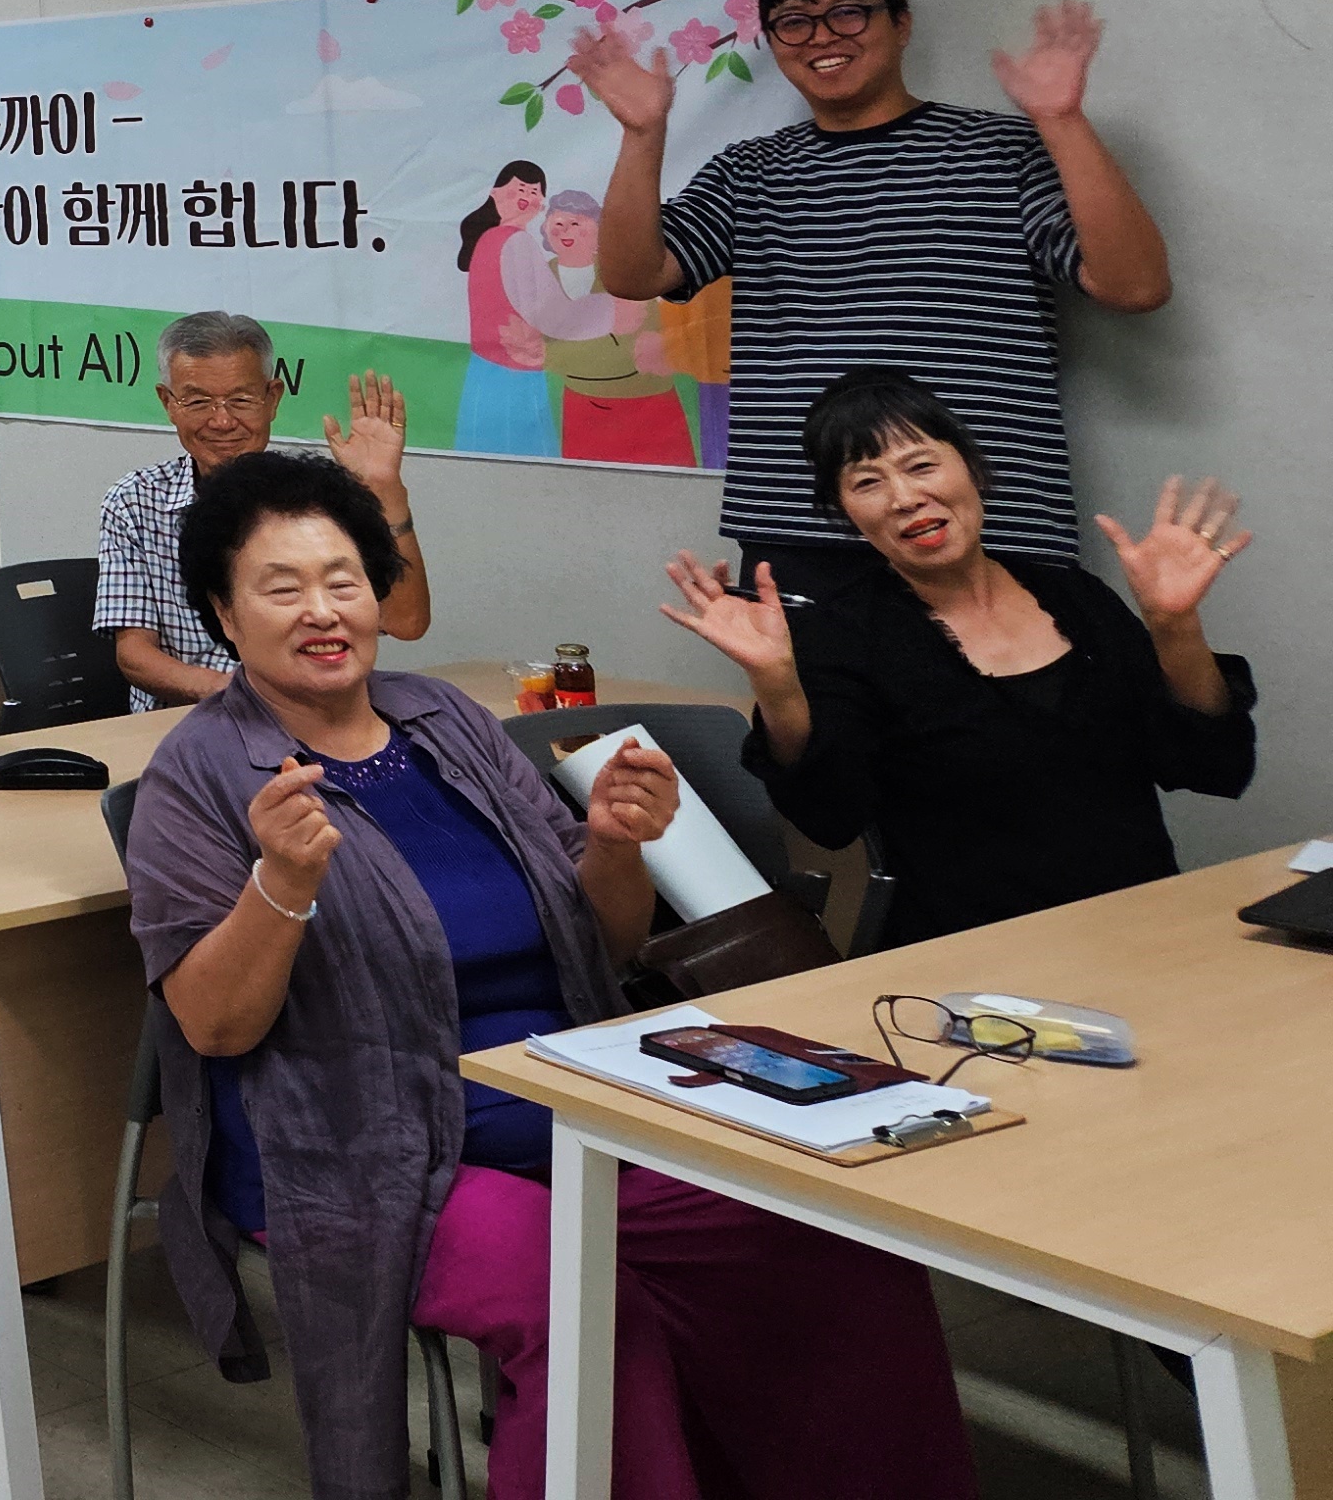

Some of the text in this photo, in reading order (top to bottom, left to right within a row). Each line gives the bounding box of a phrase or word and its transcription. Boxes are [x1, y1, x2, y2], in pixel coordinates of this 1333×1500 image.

[61, 181, 170, 247] 함께
[180, 179, 387, 253] 합니다.
[77, 331, 141, 387] AI)
